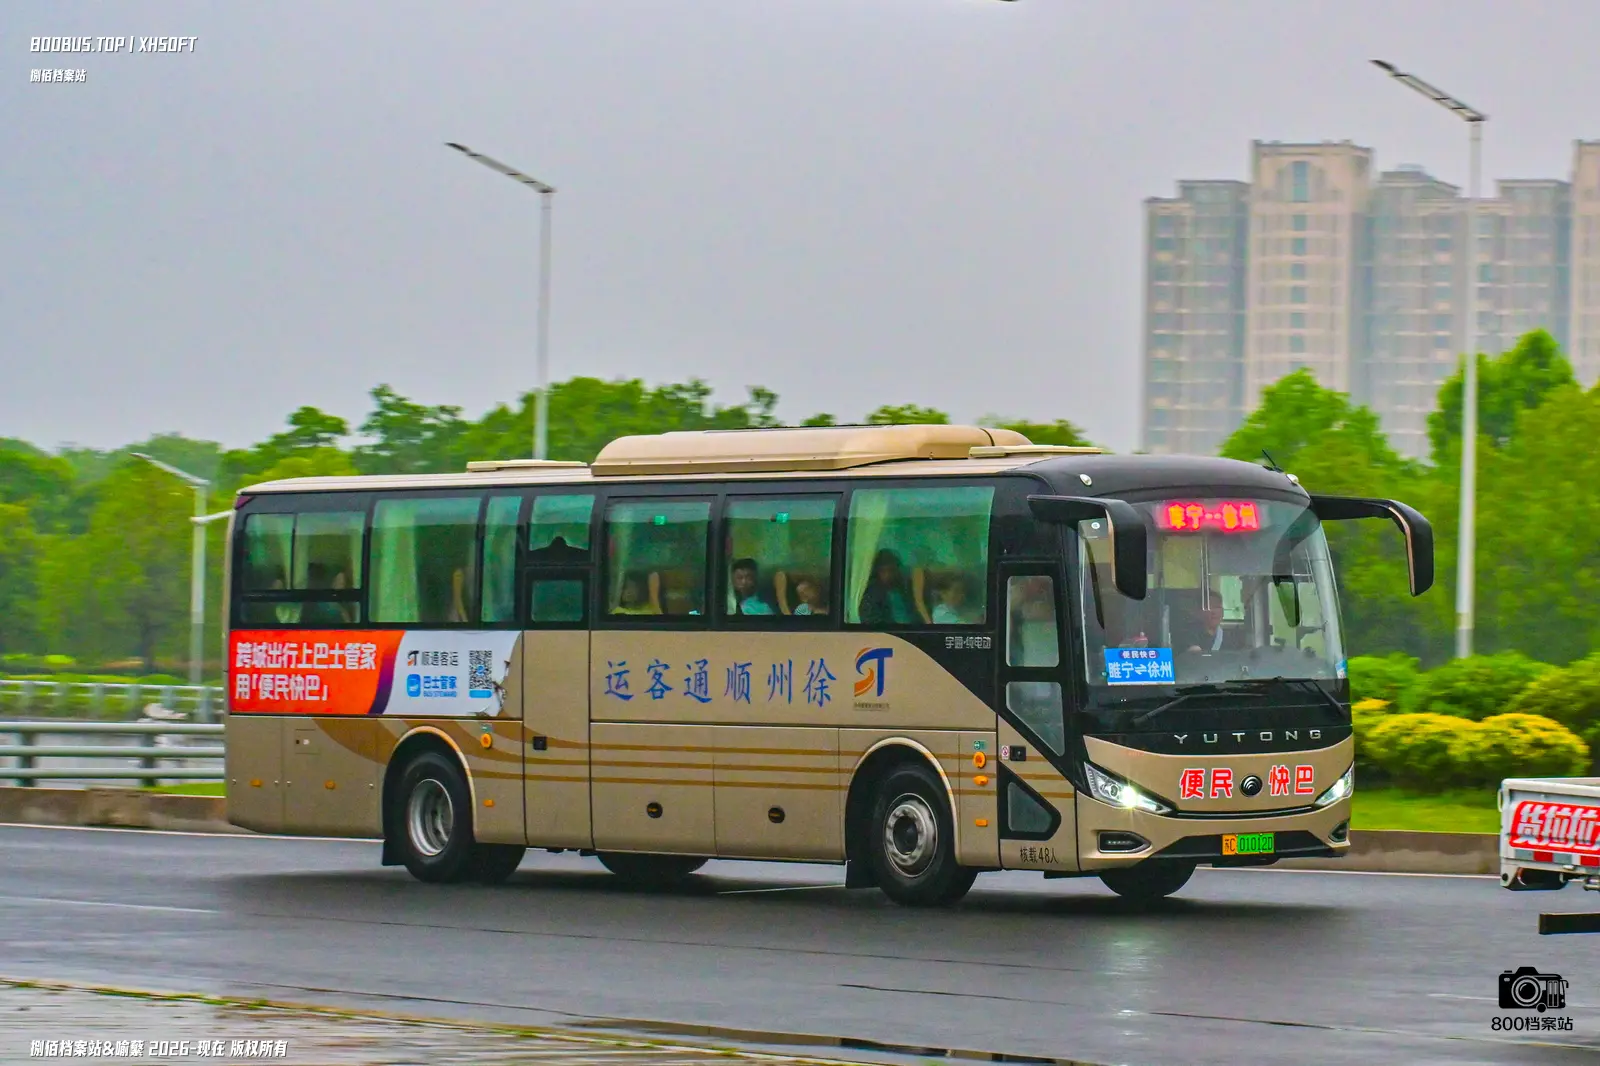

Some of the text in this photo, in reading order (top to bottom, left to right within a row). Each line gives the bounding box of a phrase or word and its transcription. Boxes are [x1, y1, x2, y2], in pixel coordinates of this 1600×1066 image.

[235, 642, 377, 670] 跨城出行上巴士管家
[1122, 650, 1157, 659] 便民快巴
[1173, 729, 1322, 745] YUTONG
[1179, 764, 1315, 800] 便民 快巴
[1513, 804, 1600, 851] 货拉拉
[1020, 847, 1059, 864] 核载48人
